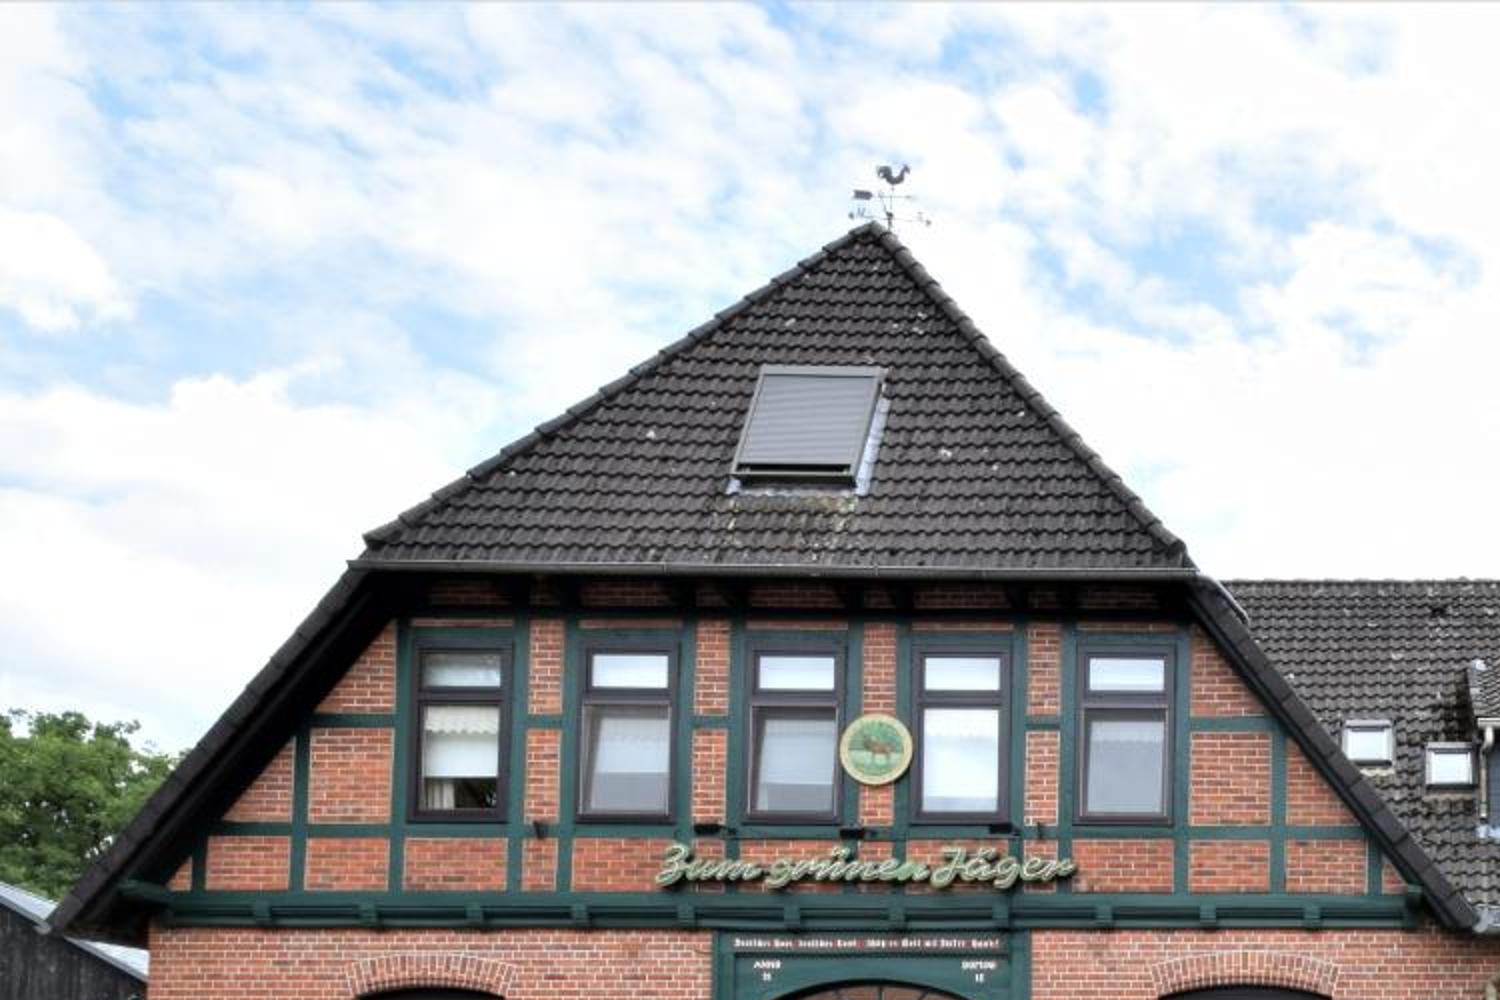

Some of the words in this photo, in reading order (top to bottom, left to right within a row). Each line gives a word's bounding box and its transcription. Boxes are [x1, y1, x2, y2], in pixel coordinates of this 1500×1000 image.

[655, 843, 762, 888] Zum
[764, 845, 931, 889] grünen
[930, 846, 1077, 889] Jäger
